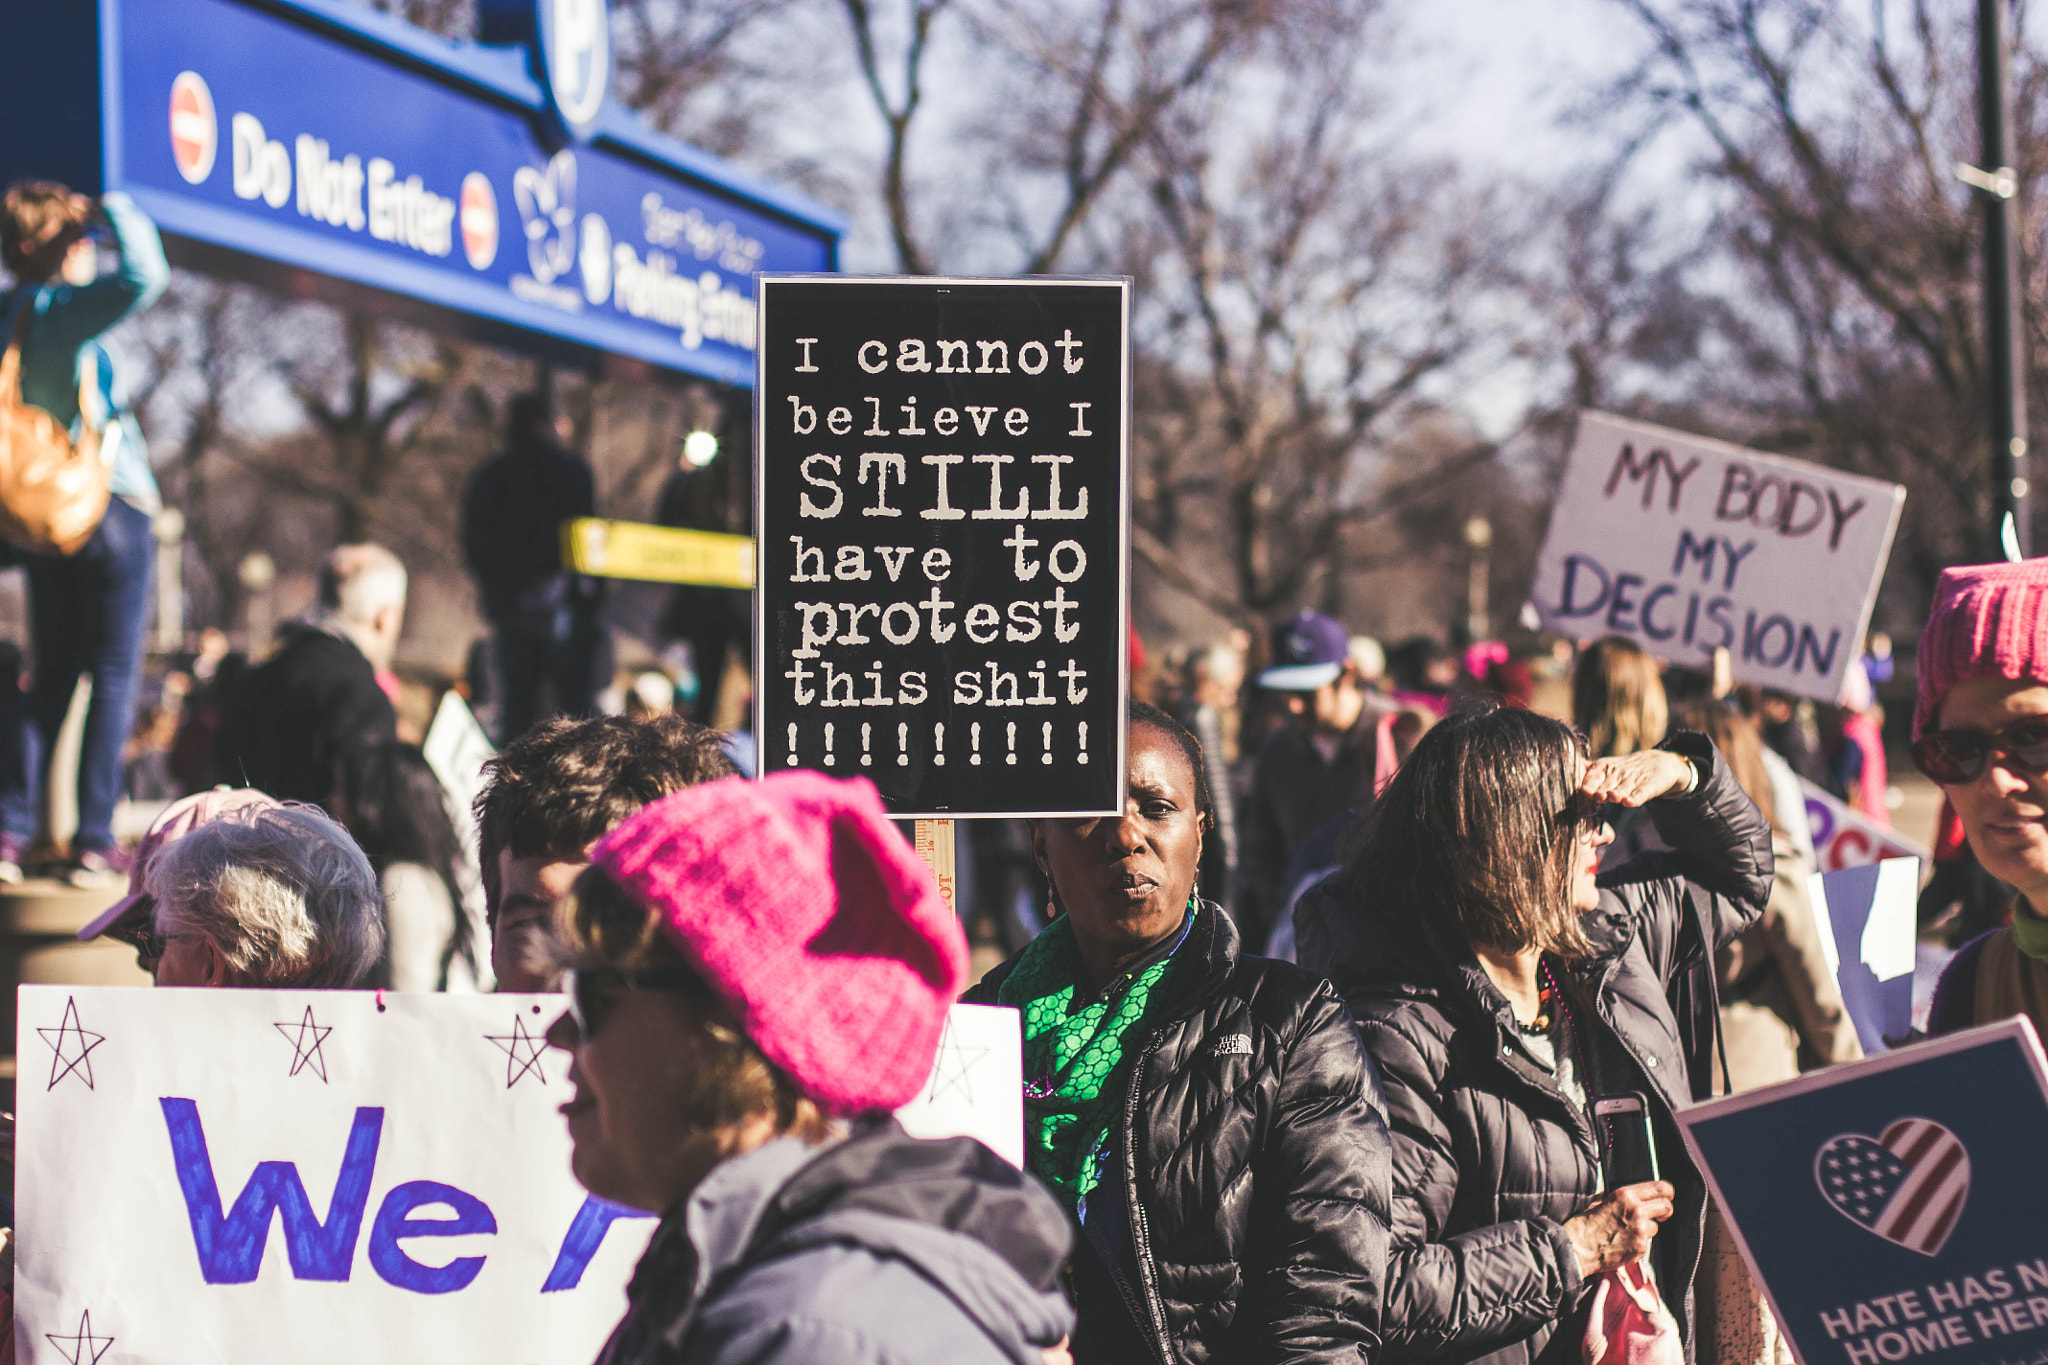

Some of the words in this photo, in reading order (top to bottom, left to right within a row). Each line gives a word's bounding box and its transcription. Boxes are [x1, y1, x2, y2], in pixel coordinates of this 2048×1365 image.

[232, 111, 292, 209] Do
[295, 132, 366, 233] Not
[368, 156, 456, 258] Enter
[794, 337, 820, 373] I
[857, 328, 1084, 376] cannot
[786, 395, 1030, 437] believe
[1068, 401, 1093, 437] I
[799, 451, 1089, 521] STILL
[1604, 441, 1701, 513] MY
[1716, 461, 1866, 552] BODY
[789, 534, 952, 583] have
[1002, 523, 1087, 583] to
[1671, 528, 1757, 593] MY
[791, 585, 1081, 660] protest
[1551, 552, 1842, 678] DECISION
[784, 659, 928, 708] this
[953, 658, 1089, 708] shit
[158, 1096, 498, 1295] We
[1819, 1290, 1928, 1341] HATE
[1926, 1267, 2015, 1315] HAS
[1842, 1314, 1975, 1365] HOME
